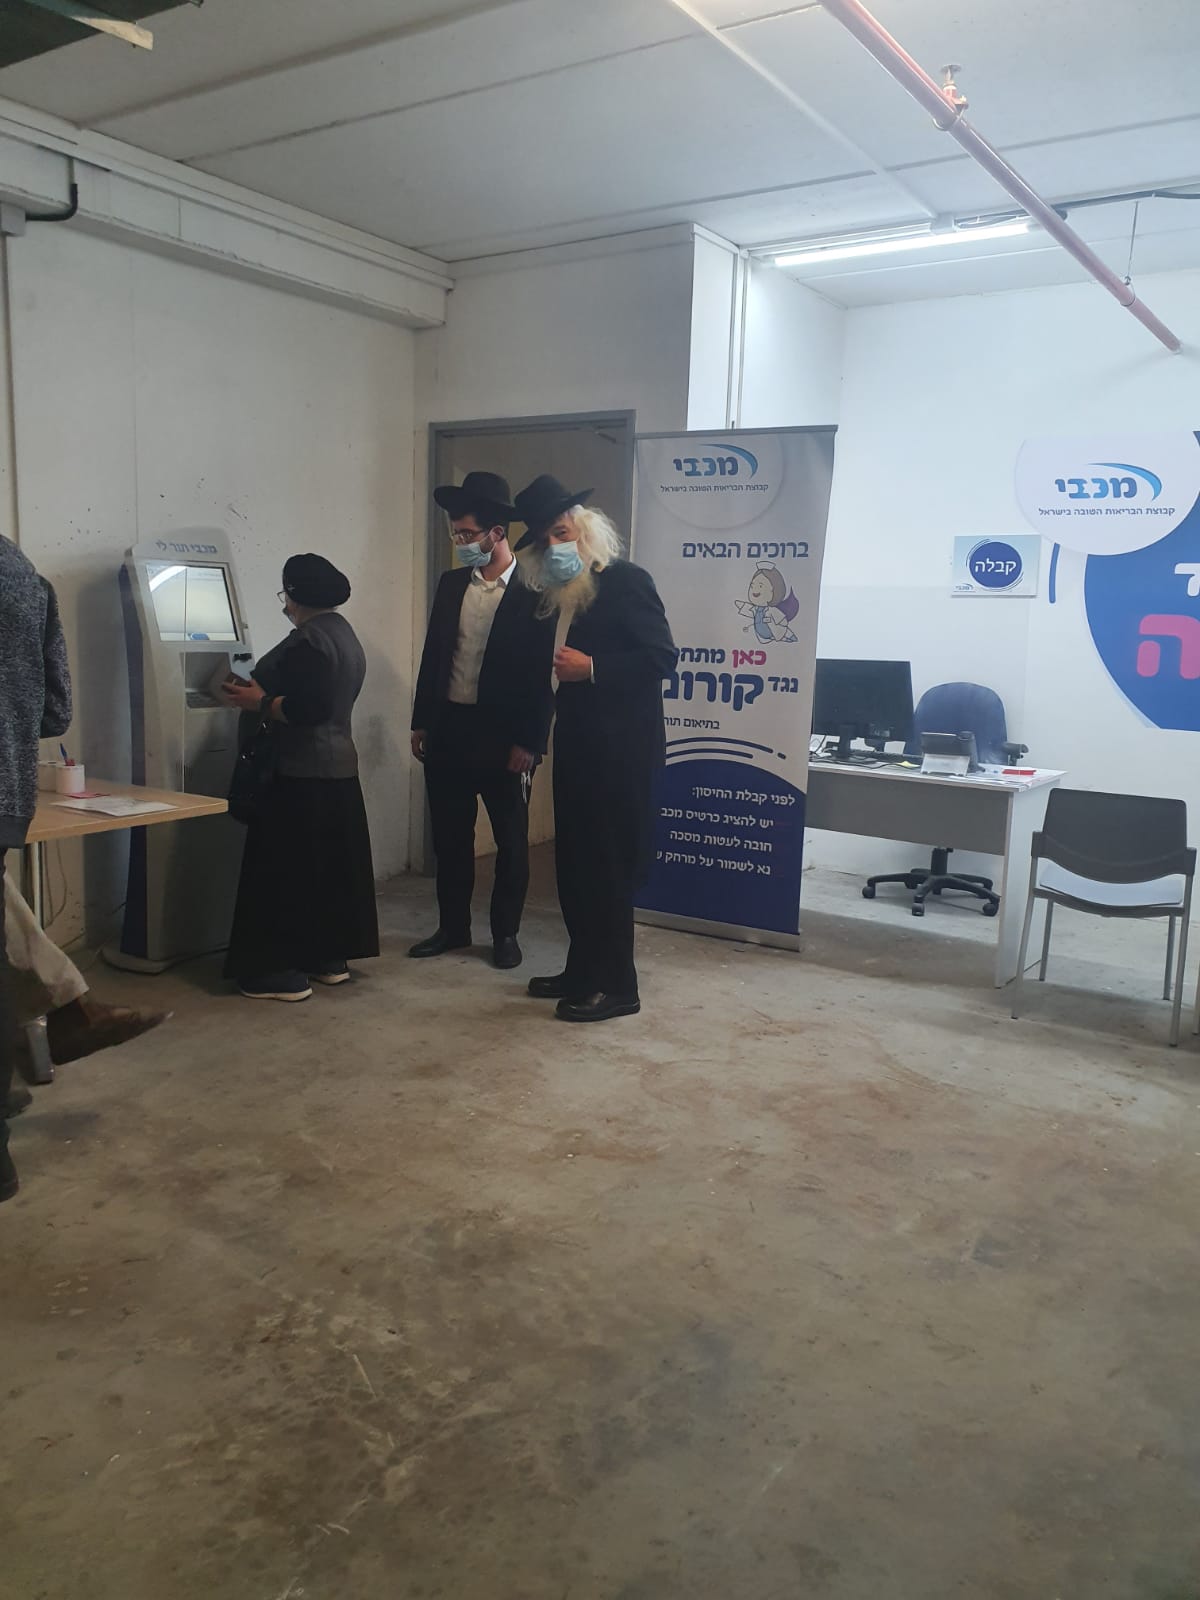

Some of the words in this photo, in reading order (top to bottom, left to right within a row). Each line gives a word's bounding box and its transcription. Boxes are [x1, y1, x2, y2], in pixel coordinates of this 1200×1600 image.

[673, 456, 739, 477] מכבי
[660, 485, 688, 493] בישראל
[745, 484, 769, 492] קבוצת
[1054, 477, 1138, 499] מכבי
[1038, 508, 1072, 516] בישראל
[1073, 508, 1103, 516] הטובה
[1105, 507, 1143, 516] הבריאות
[1145, 507, 1176, 516] קבוצת
[682, 542, 741, 558] הבאים
[746, 541, 809, 558] ברוכים
[975, 557, 1017, 576] קבלה
[731, 649, 767, 668] כאן
[767, 676, 799, 693] נגד
[683, 718, 720, 730] בתיאום
[691, 786, 733, 799] החיסון:
[735, 789, 768, 805] קבלת
[771, 794, 796, 807] לפני
[685, 810, 720, 823] כרטיס
[722, 814, 756, 827] להציג
[759, 818, 774, 829] יש
[669, 830, 701, 843] מסכה
[703, 836, 741, 848] לעטות
[743, 839, 773, 852] חובה
[665, 851, 696, 864] מרחק
[699, 854, 714, 867] על
[717, 858, 754, 872] לשמור
[756, 864, 771, 875] נא
